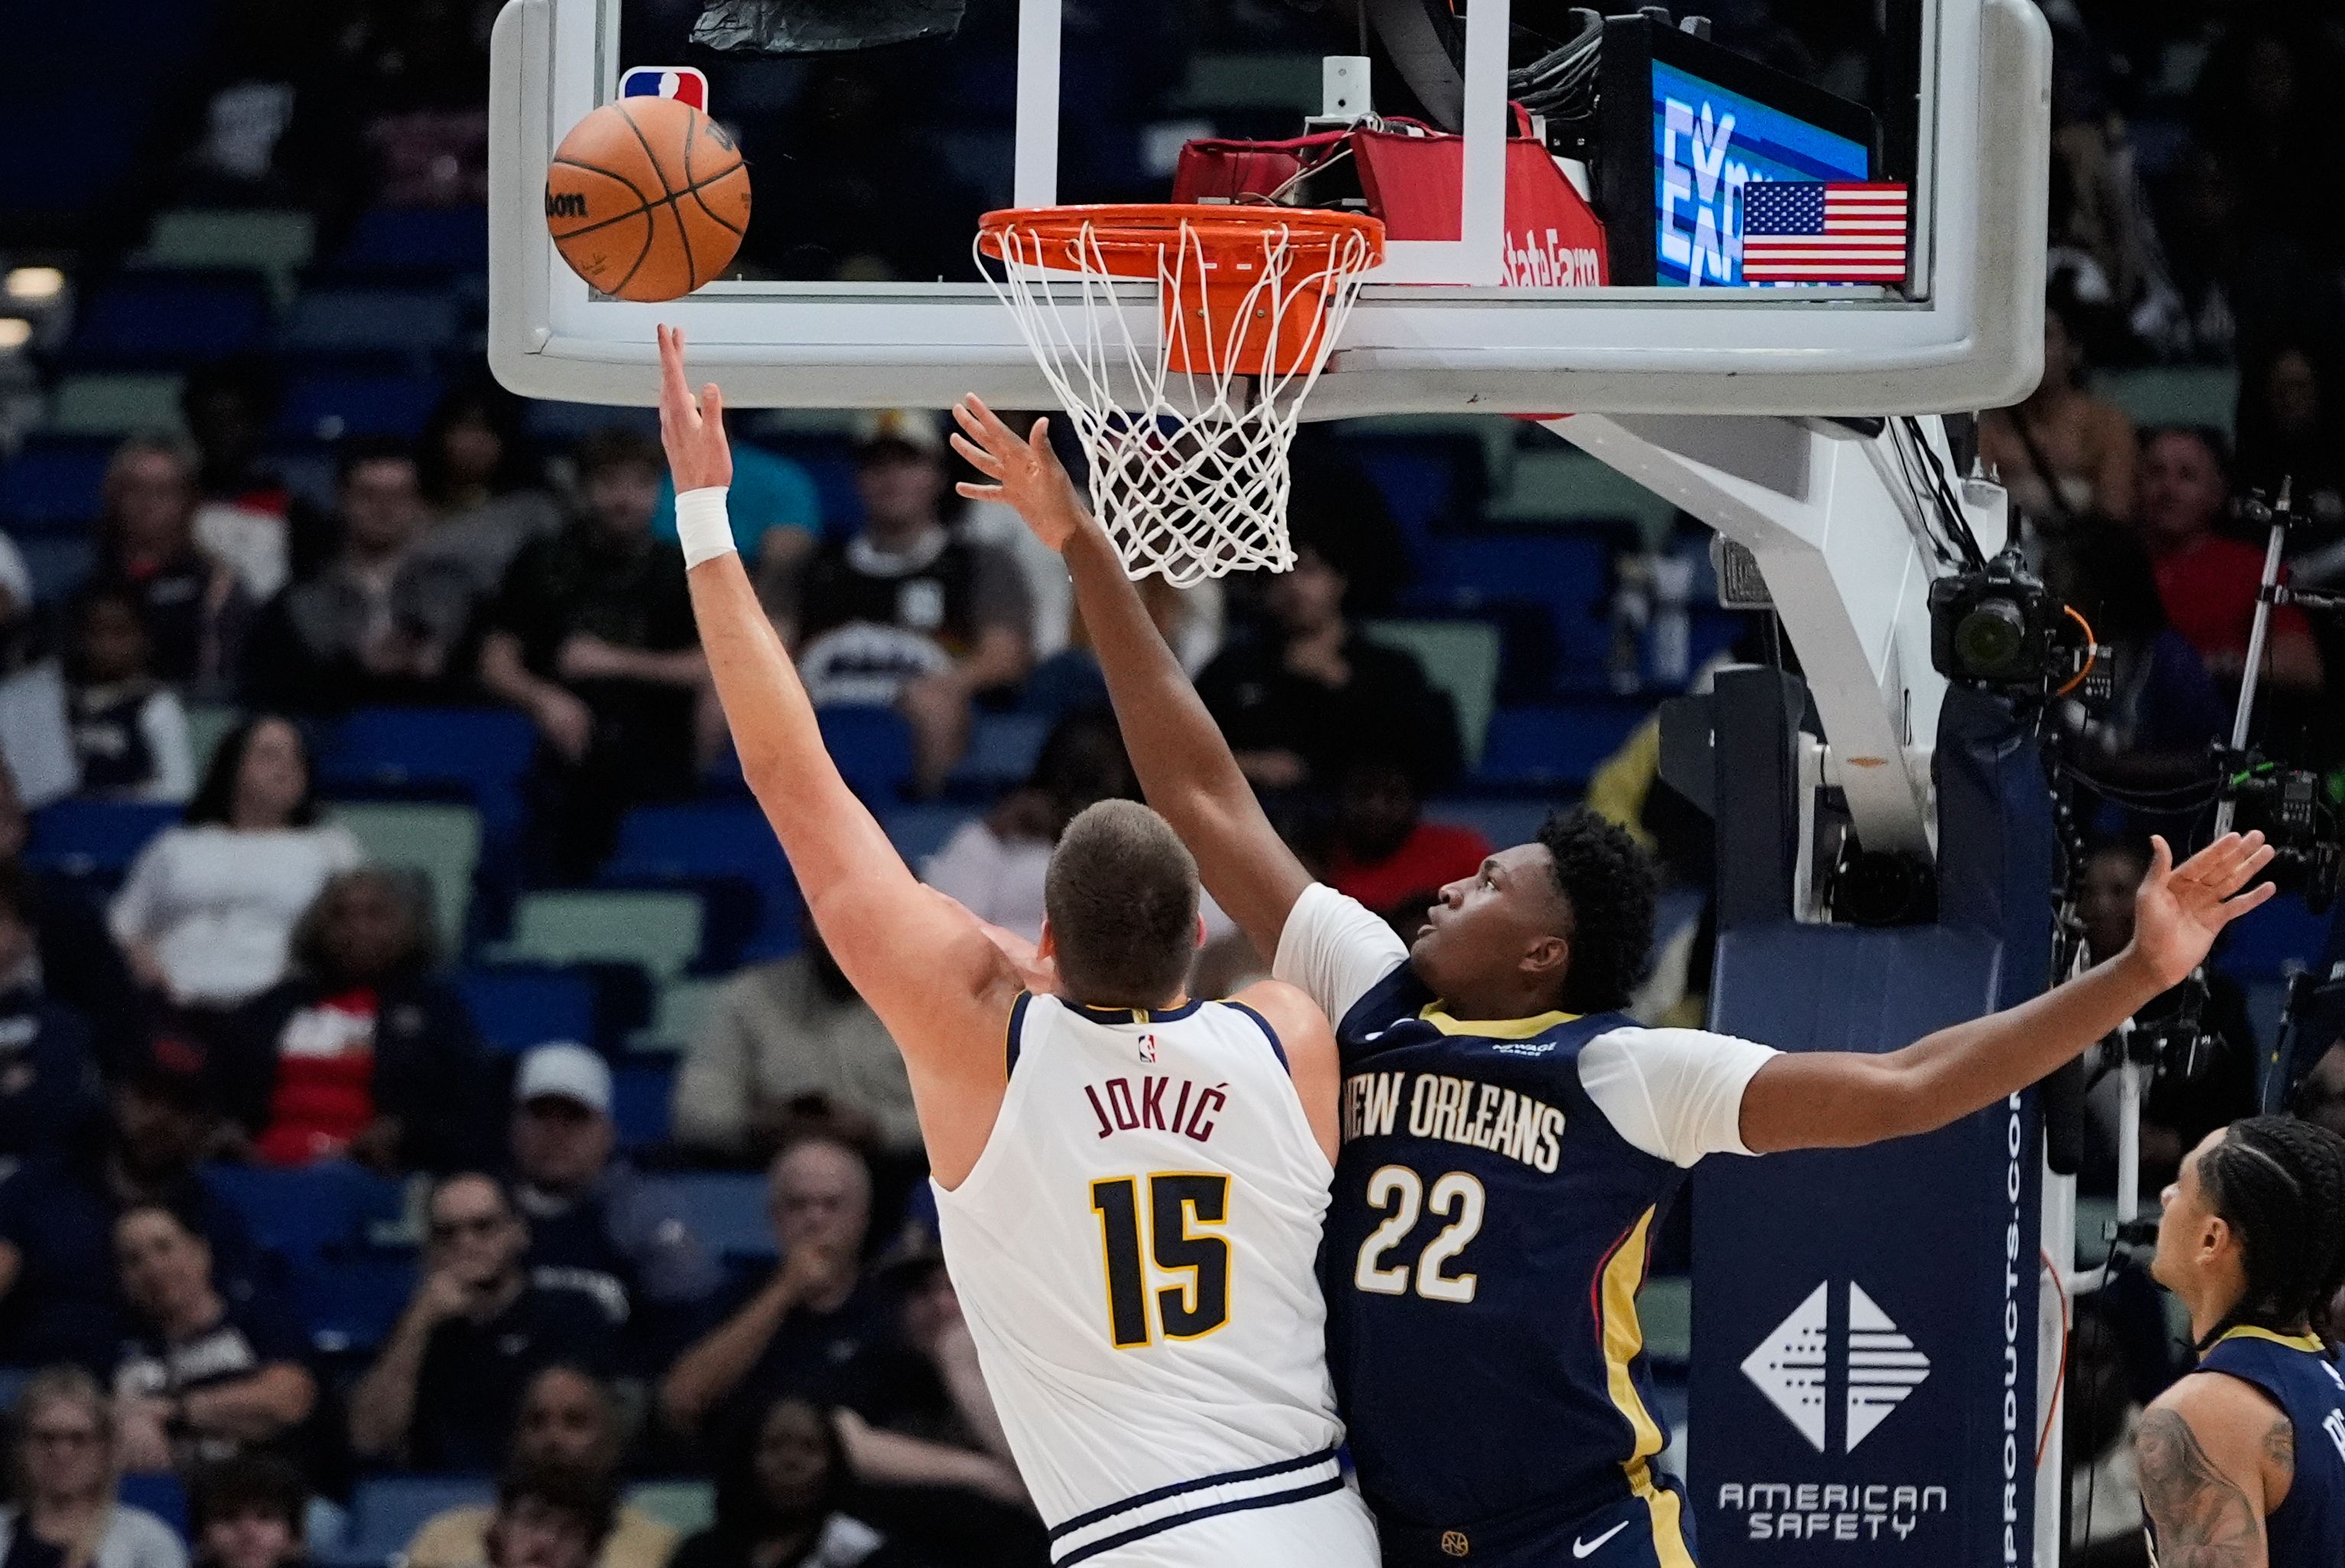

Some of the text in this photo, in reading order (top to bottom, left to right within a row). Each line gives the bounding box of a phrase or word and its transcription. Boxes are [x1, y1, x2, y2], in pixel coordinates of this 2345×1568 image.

[1085, 1076, 1230, 1143] JOKIĆ
[1409, 1073, 1566, 1173] ORLEANS
[1089, 1170, 1232, 1349] 15
[1355, 1164, 1485, 1303] 22
[2004, 1090, 2021, 1568] PRODUCTS.CO
[1720, 1483, 1947, 1512] AMERICAN
[1748, 1512, 1916, 1540] SAFETY
